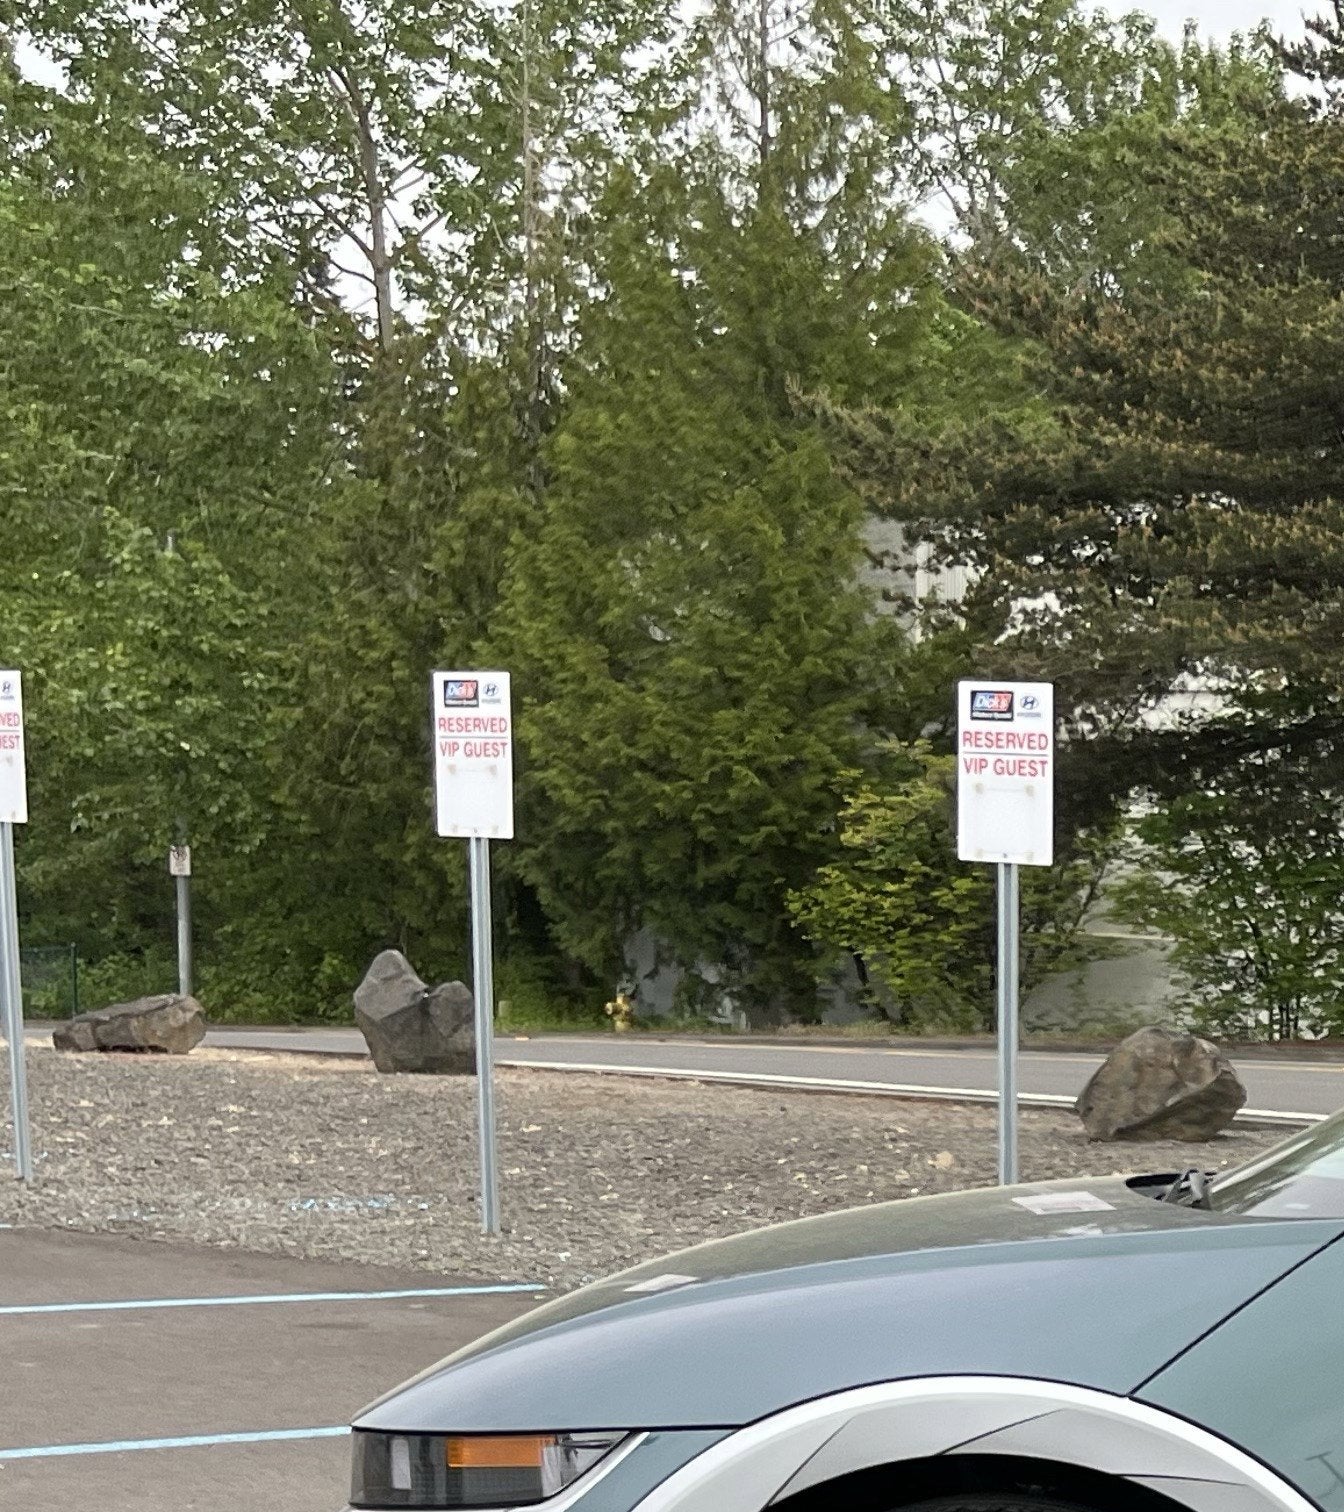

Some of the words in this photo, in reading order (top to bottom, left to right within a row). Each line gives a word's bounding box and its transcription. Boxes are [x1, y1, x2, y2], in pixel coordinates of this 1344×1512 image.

[438, 717, 508, 733] RESERVED
[439, 741, 459, 757] VIP
[464, 741, 508, 758] GUEST
[962, 731, 1048, 750] RESERVED
[963, 758, 988, 774] VIP
[993, 759, 1048, 777] GUEST
